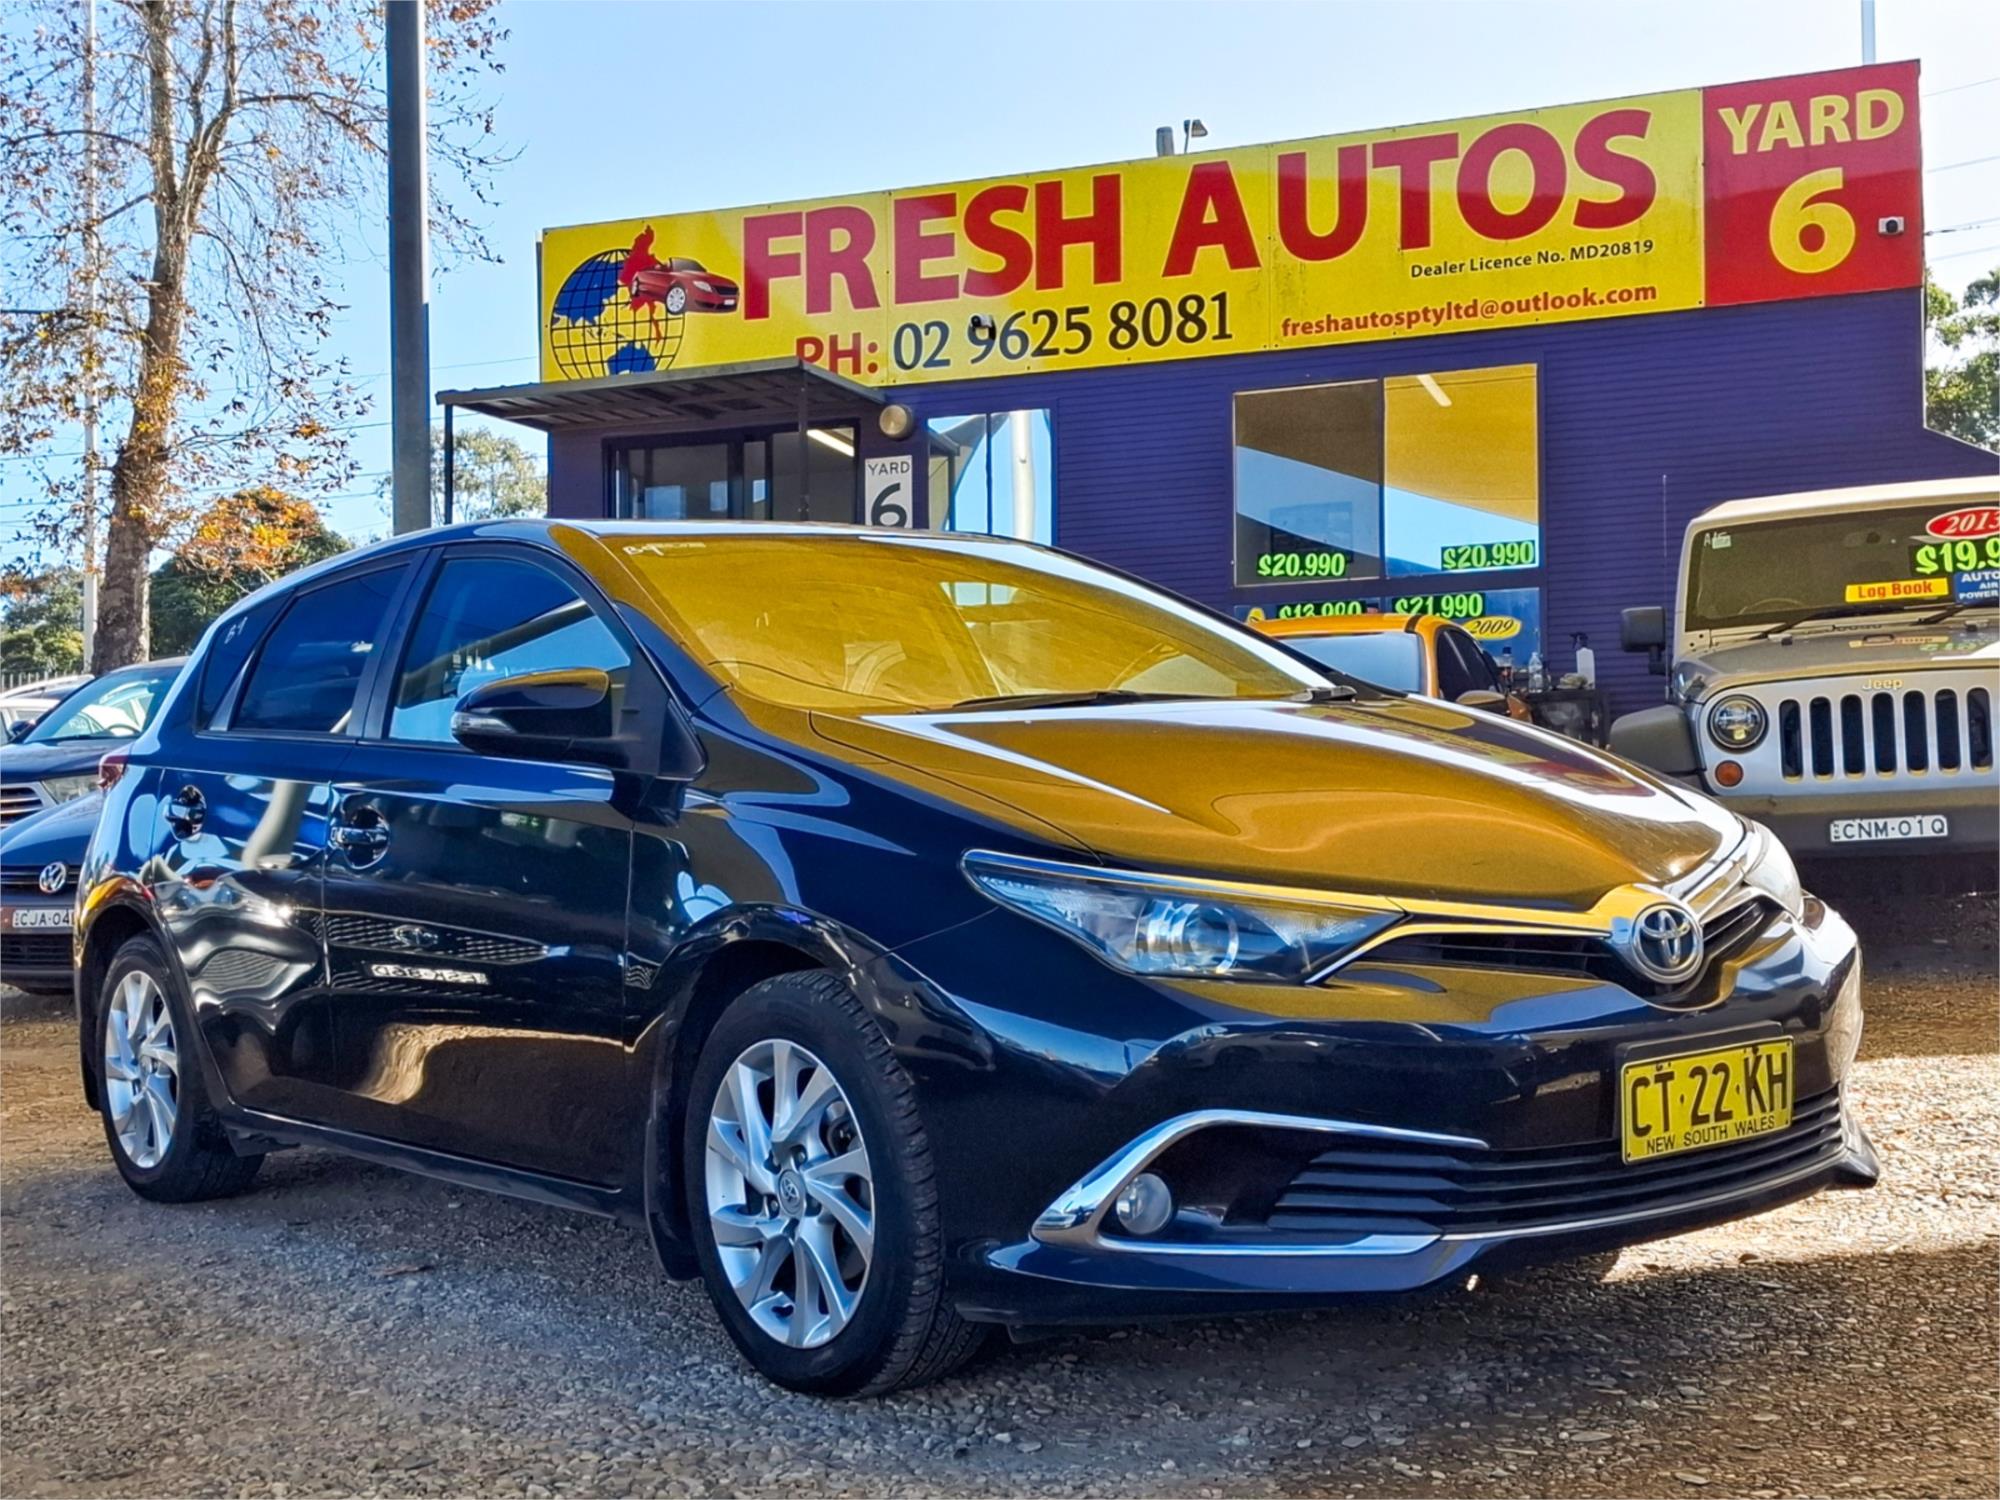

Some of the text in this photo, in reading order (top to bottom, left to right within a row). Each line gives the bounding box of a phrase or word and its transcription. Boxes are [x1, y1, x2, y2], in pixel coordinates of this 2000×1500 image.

[1718, 88, 1904, 155] YARD
[743, 108, 1657, 320] FRESH AUTOS
[1768, 167, 1856, 274] 6
[1411, 239, 1653, 278] Dealer Licence No. MD20819
[1281, 285, 1657, 337] freshautosptyltd@outlook.com
[796, 291, 1233, 375] PH: 02 9625 8081
[868, 461, 910, 475] YARD
[871, 482, 907, 527] 6
[1257, 552, 1346, 577] $20.990
[1442, 541, 1534, 570] $20.990
[1858, 581, 1933, 599] Log Book
[1959, 590, 1998, 600] POWER
[1470, 619, 1514, 634] 2009
[1862, 678, 1904, 690] Jeep
[1646, 1115, 1775, 1154] NEW SOUTH WALES
